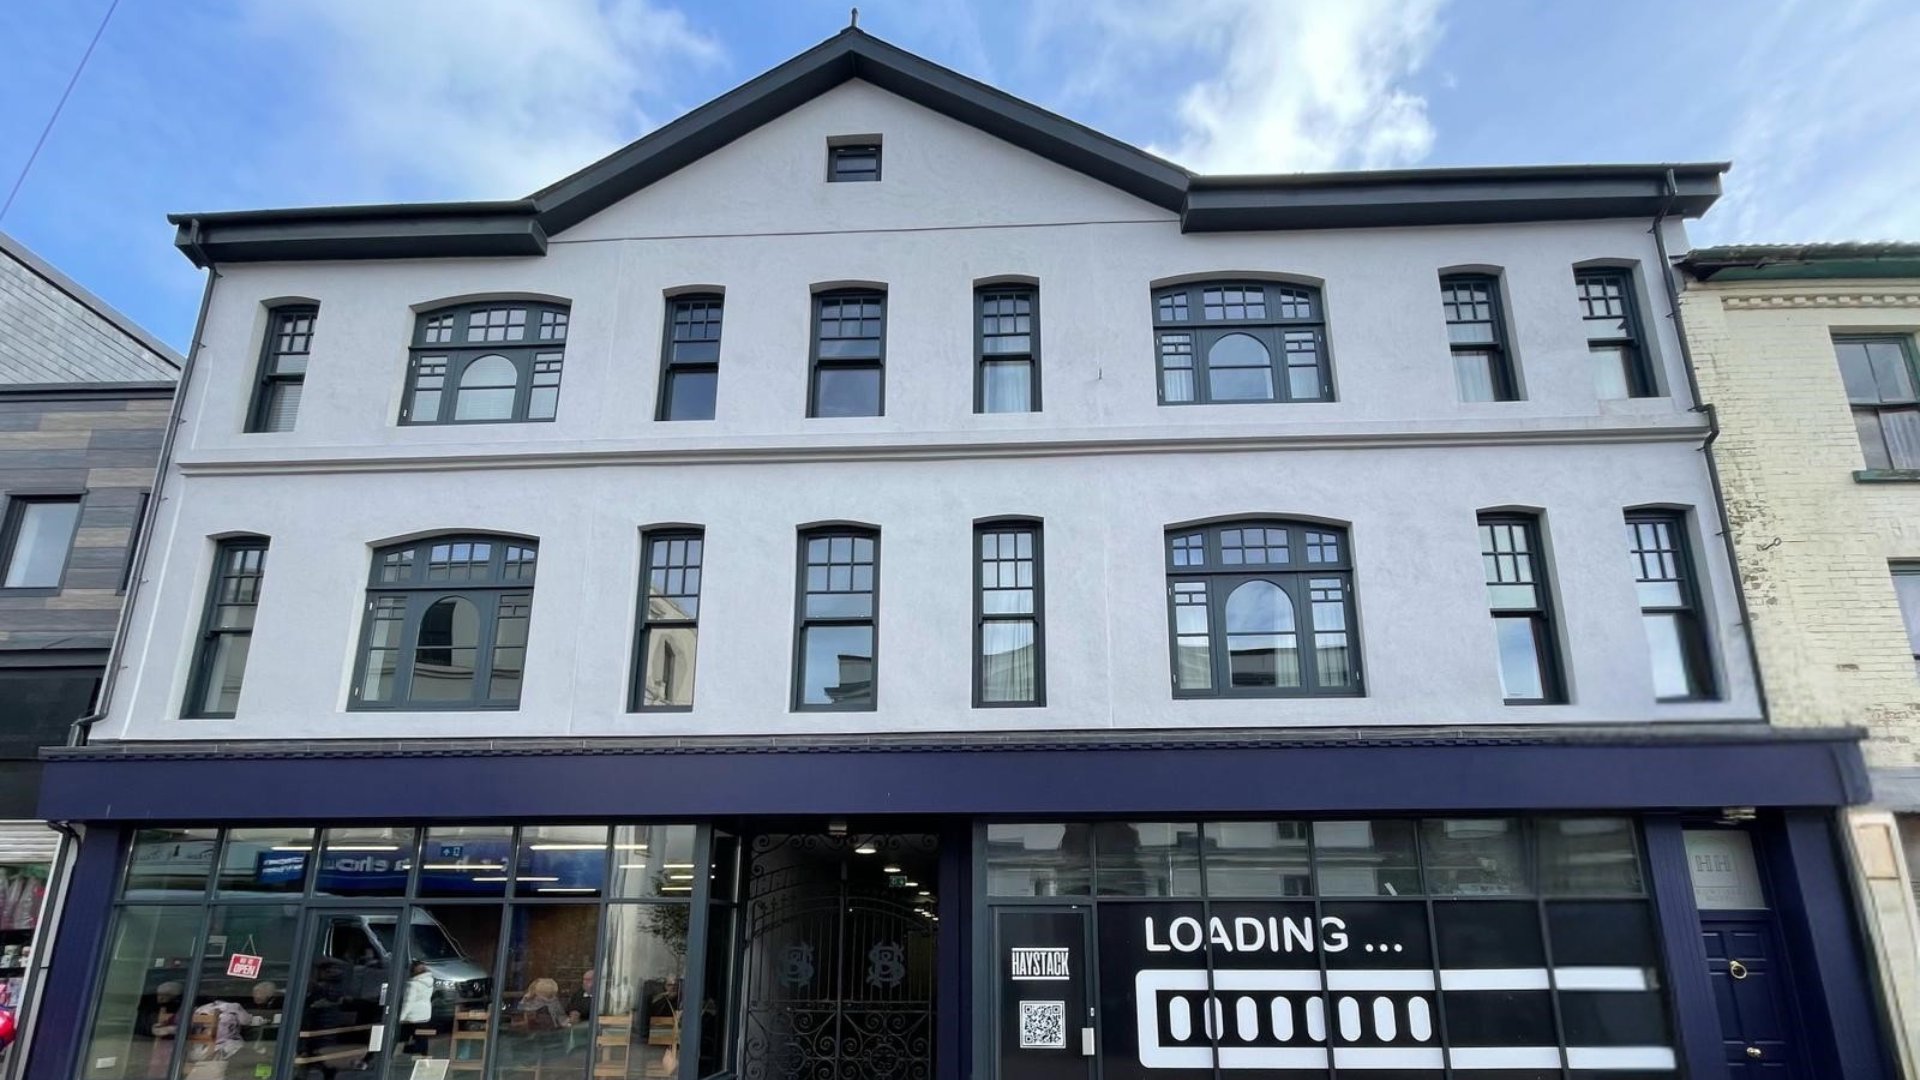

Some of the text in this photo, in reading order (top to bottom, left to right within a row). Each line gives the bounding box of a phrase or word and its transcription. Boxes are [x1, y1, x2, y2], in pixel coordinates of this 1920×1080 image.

[1144, 916, 1349, 952] LOADING
[233, 963, 256, 976] OPEN
[1012, 952, 1070, 975] HAYSTACK
